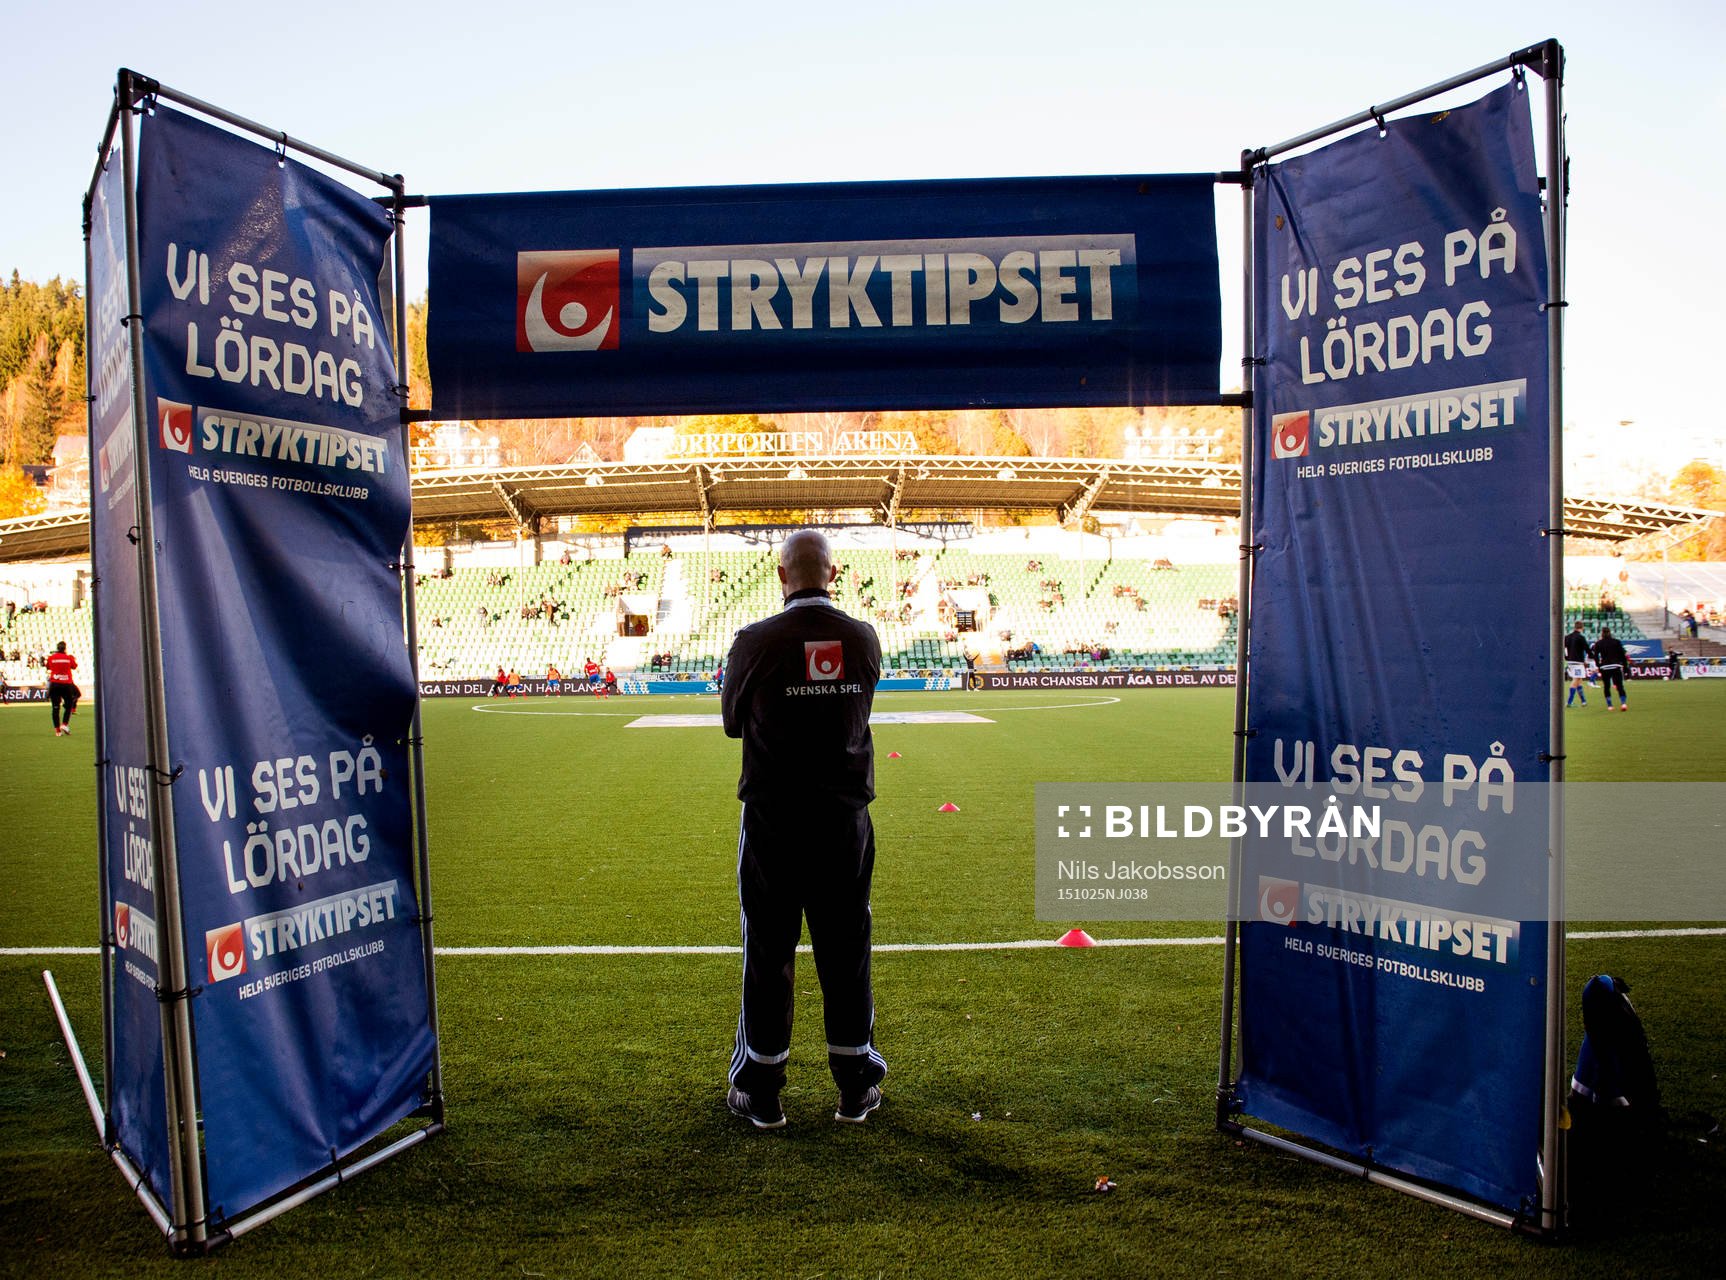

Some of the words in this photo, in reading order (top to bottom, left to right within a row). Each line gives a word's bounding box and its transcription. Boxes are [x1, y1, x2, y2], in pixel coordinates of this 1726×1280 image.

[648, 249, 1121, 333] STRYKTIPSET
[1281, 267, 1318, 320] VI
[1332, 241, 1426, 310] SES
[1445, 207, 1517, 286] PÅ
[167, 243, 209, 304] VI
[228, 262, 317, 329] SES
[329, 289, 375, 349] PÅ
[186, 316, 363, 407] LÖRDAG
[1301, 301, 1492, 385] LÖRDAG
[202, 416, 387, 473] STRYKTIPSET
[835, 431, 918, 450] ARENA
[1319, 387, 1519, 447] STRYKTIPSET
[188, 465, 210, 482] HELA
[213, 470, 268, 488] SVERIGES
[272, 477, 369, 500] FOTBOLLSKLUBB
[1297, 465, 1325, 478] HELA
[1329, 459, 1385, 476] SVERIGES
[1389, 448, 1493, 471] FOTBOLLSKLUBB
[33, 690, 48, 699] AT
[445, 684, 460, 694] EN
[464, 684, 486, 694] DEL
[786, 685, 837, 696] SVENSKA
[840, 684, 863, 694] SPEL
[992, 677, 1009, 687] DU
[1013, 677, 1038, 687] HAR
[1041, 676, 1098, 687] CHANSEN
[1102, 675, 1124, 686] ATT
[1127, 674, 1153, 685] ÄGA
[1156, 675, 1172, 685] EN
[1175, 674, 1198, 685] DEL
[1200, 674, 1216, 684] AV
[1219, 674, 1237, 684] DE
[115, 765, 127, 814] VI
[128, 767, 146, 820] SES
[199, 765, 236, 822] VI
[251, 755, 320, 813] SES
[329, 734, 383, 799] PÅ
[1274, 738, 1314, 790] VI
[1330, 744, 1424, 803] SES
[1443, 741, 1515, 814] PÅ
[123, 820, 154, 892] LÖRDA
[223, 813, 370, 894] LÖRDAG
[251, 887, 396, 960] STRYKTIPSET
[1307, 892, 1512, 964] STRYKTIPSET
[239, 981, 263, 1000] HELA
[264, 965, 311, 990] SVERIGES
[313, 939, 384, 972] FOTBOLLSKLUBB
[1285, 937, 1313, 954] HELA
[1316, 944, 1374, 968] SVERIGES
[1377, 958, 1484, 993] FOTBOLLSKLUBB
